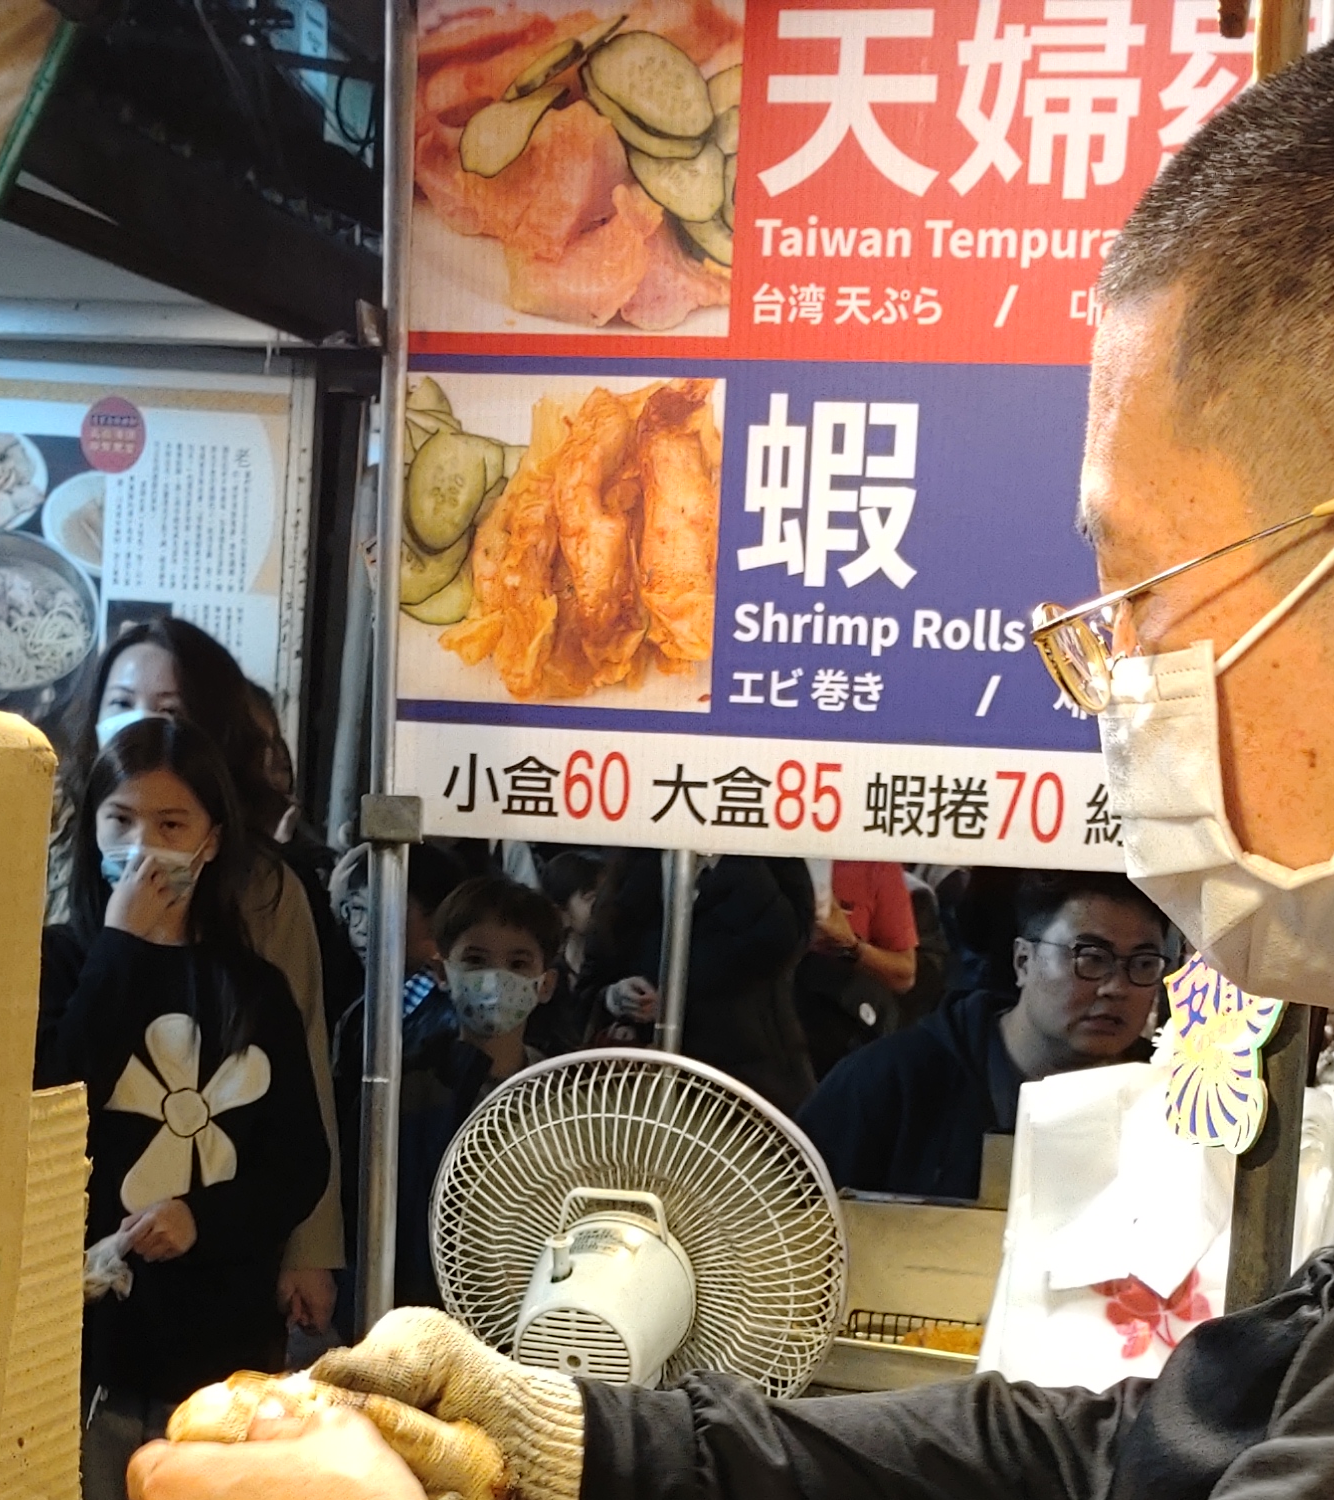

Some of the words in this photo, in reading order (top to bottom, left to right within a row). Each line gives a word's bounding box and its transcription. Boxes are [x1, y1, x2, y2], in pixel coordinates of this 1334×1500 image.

[754, 215, 912, 258] Taiwan
[925, 218, 1124, 269] Tempura
[752, 282, 825, 325] 台湾
[834, 286, 943, 325] 天ぷら
[737, 393, 919, 590] 蝦
[733, 602, 899, 656] Shrimp
[912, 609, 1026, 652] Rolls
[728, 667, 804, 708] エビ
[811, 669, 884, 712] 巻き
[443, 749, 630, 821] 小盒60
[650, 759, 843, 833] 大盒85
[863, 771, 1064, 843] 蝦捲70
